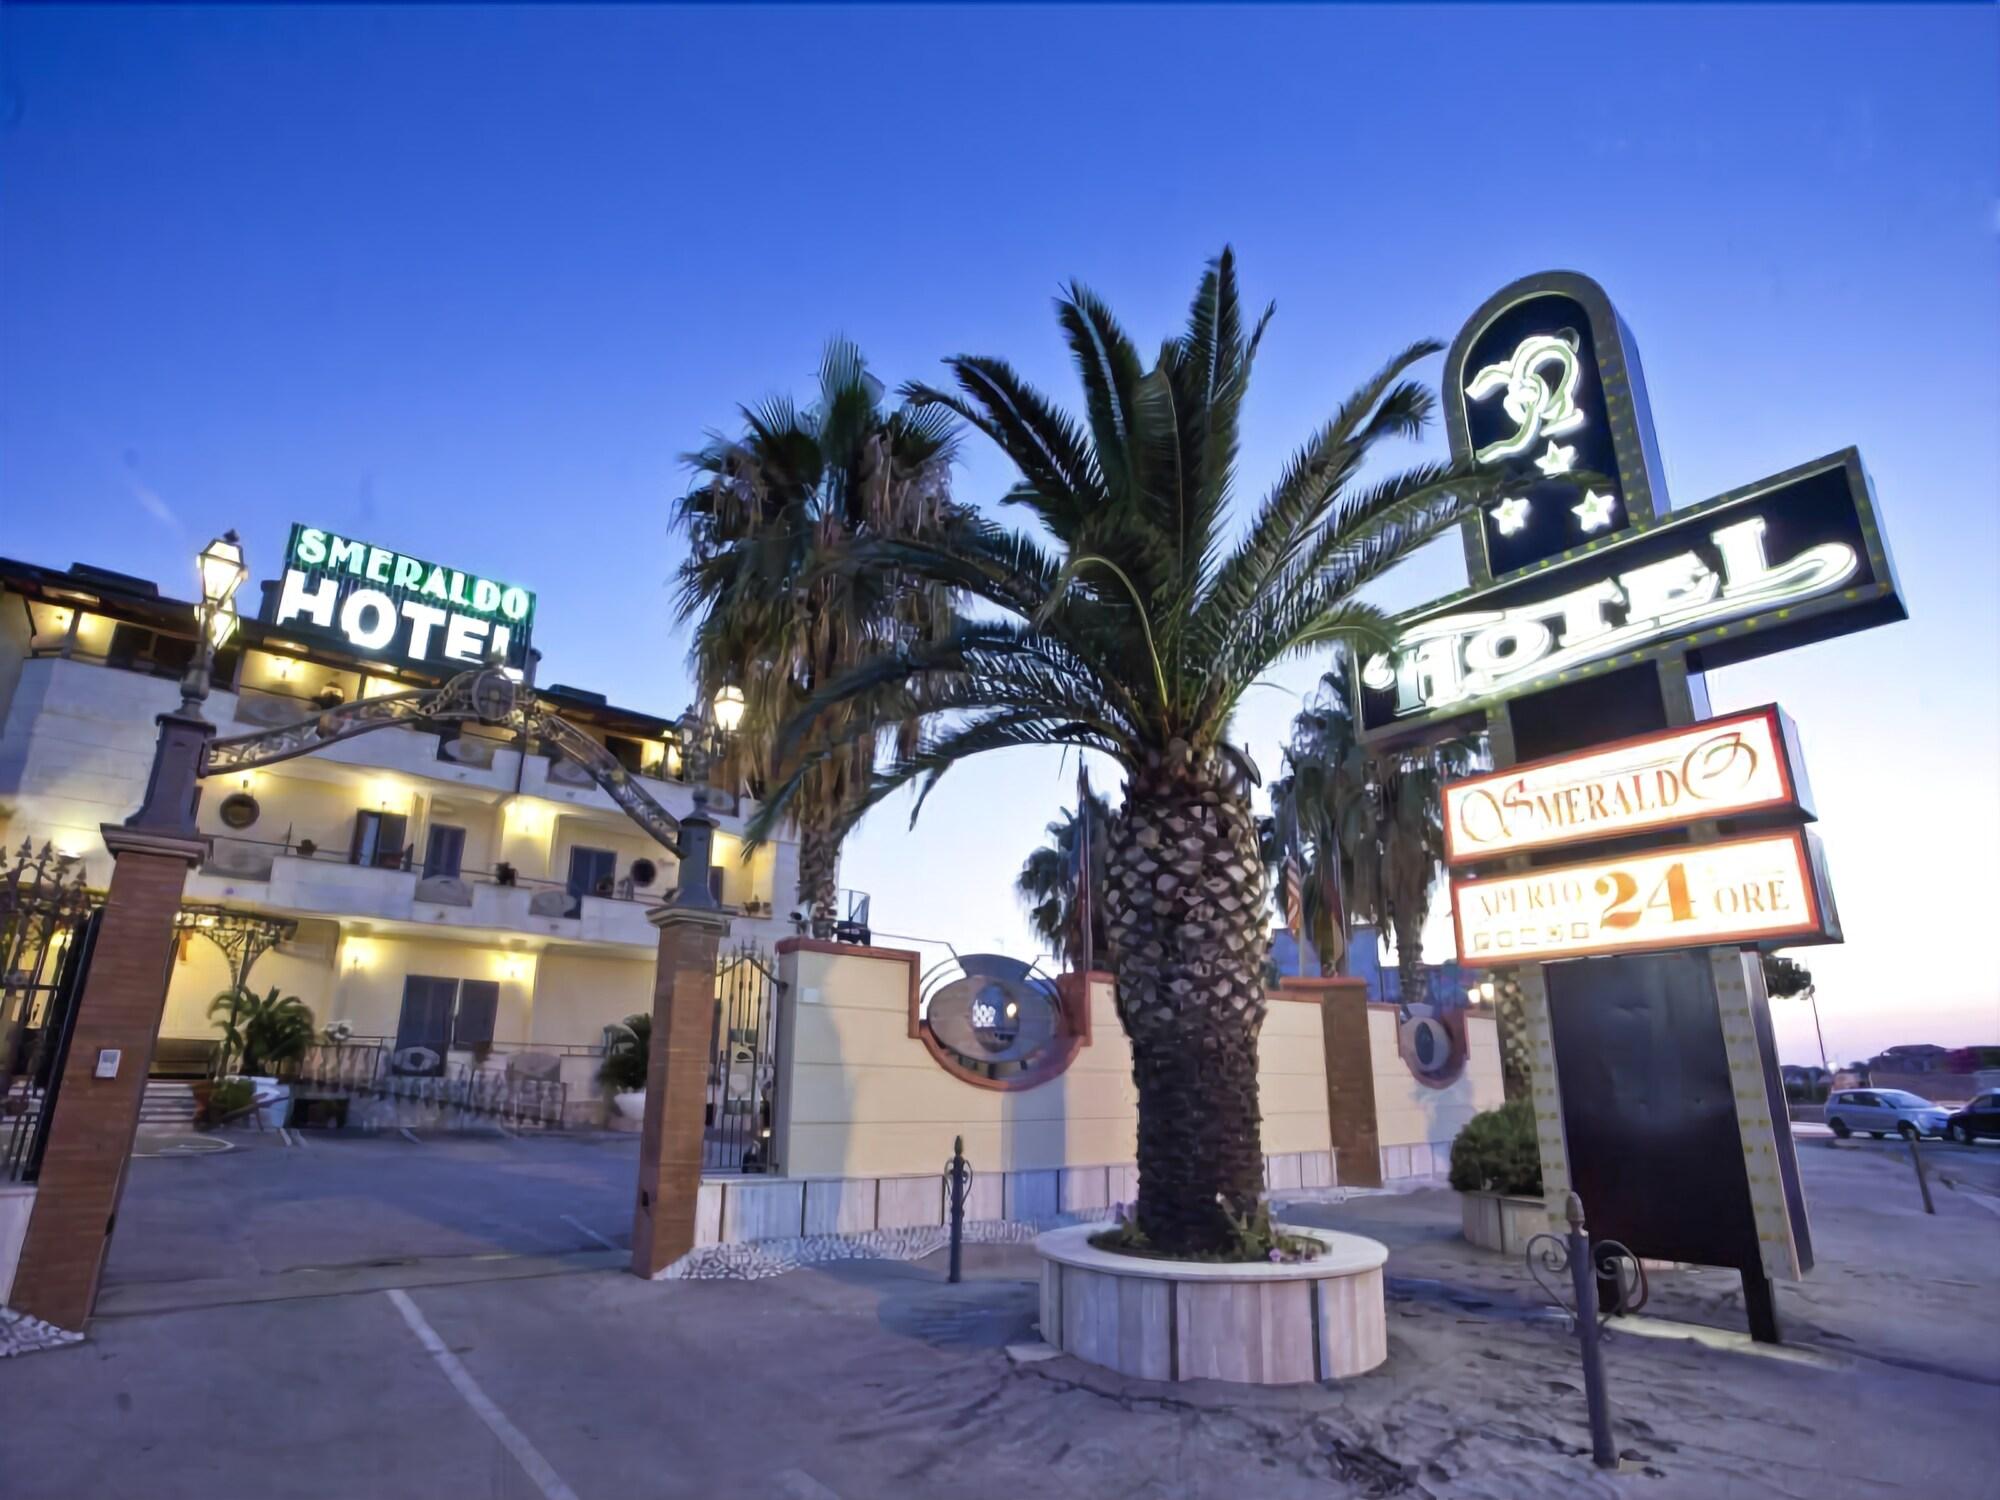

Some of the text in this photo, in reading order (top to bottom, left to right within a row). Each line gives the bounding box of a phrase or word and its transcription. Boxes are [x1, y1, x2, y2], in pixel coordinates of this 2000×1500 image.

[276, 569, 524, 683] HOTEL
[297, 528, 529, 619] SMERALDO
[1364, 514, 1858, 716] HOTEL
[1461, 731, 1758, 842] SMERALDO
[1594, 863, 1698, 930] 24
[1714, 880, 1790, 914] ORE
